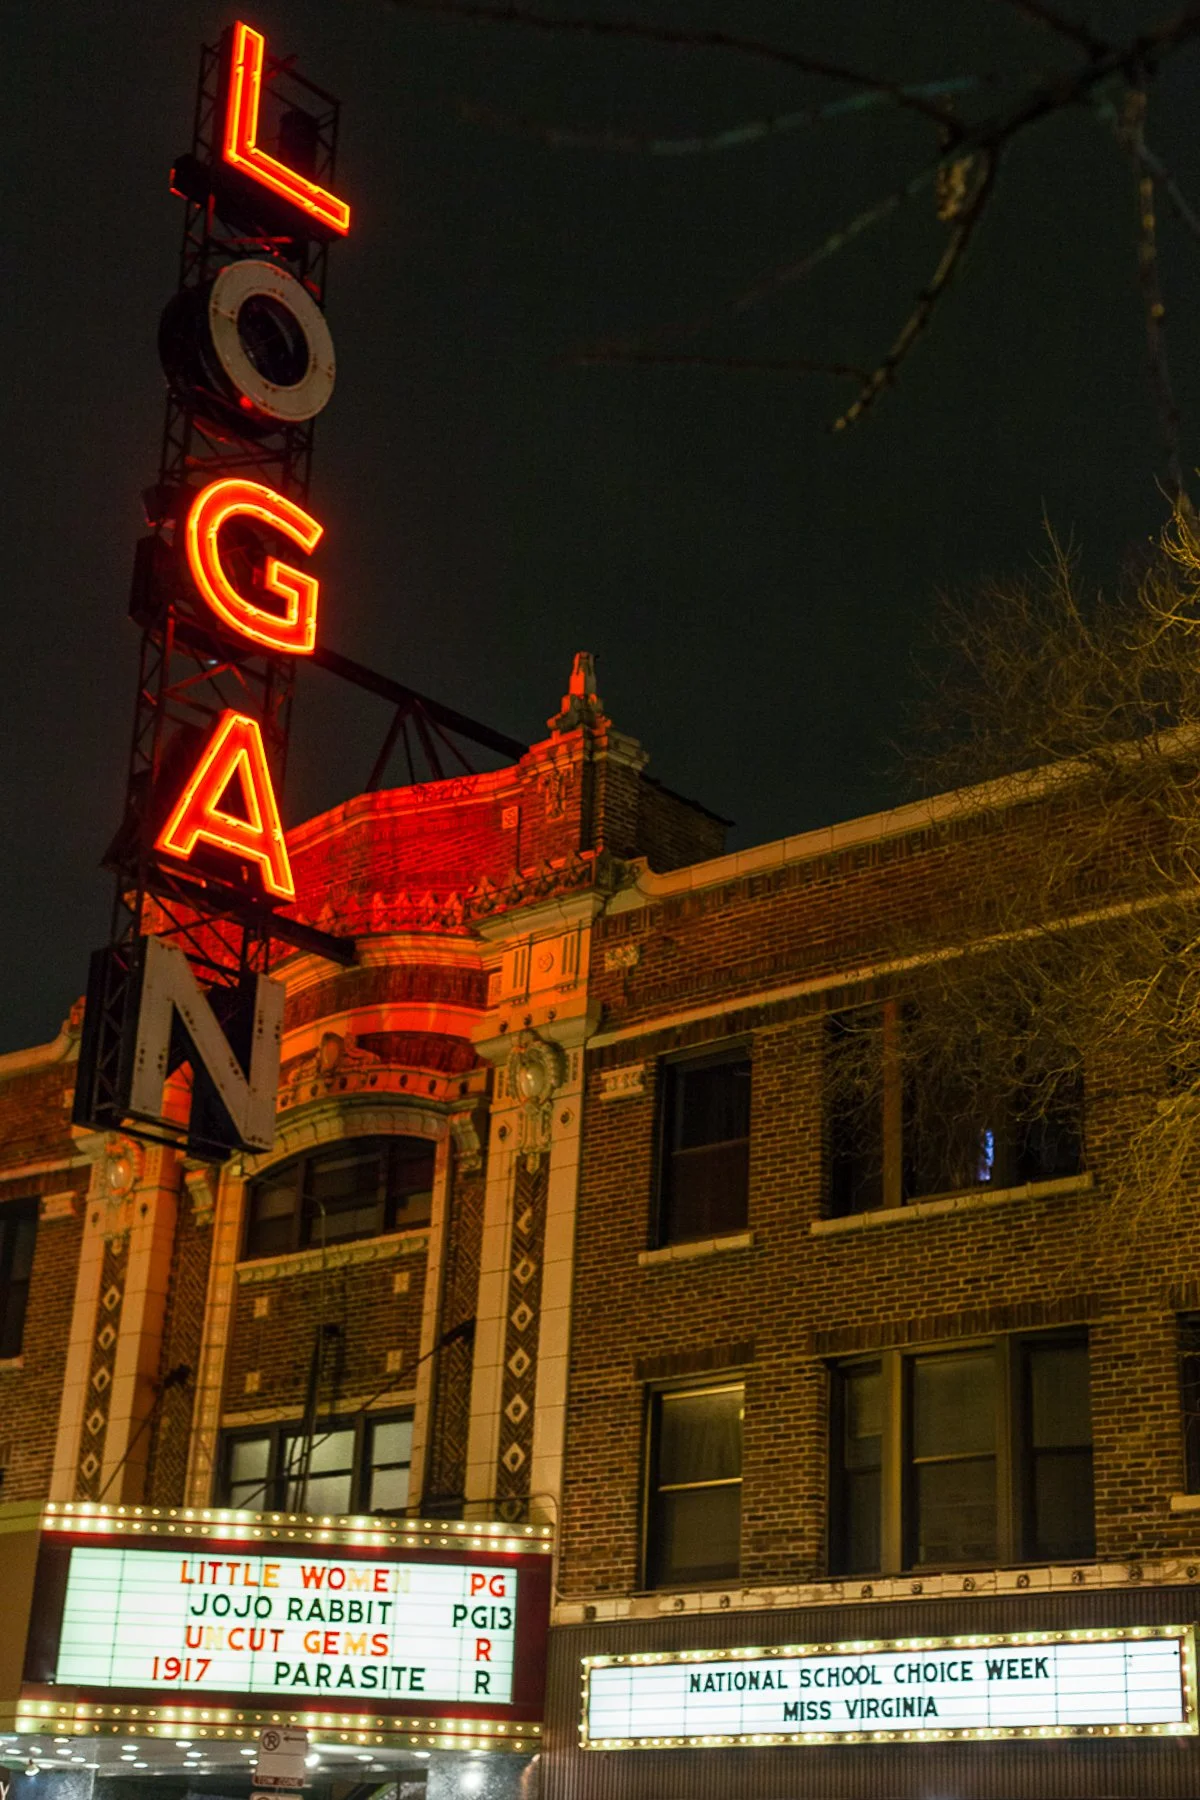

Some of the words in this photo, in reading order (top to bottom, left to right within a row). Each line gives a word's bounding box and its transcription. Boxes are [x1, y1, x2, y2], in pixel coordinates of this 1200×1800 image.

[128, 20, 352, 1152] LOGAN
[180, 1560, 281, 1588] LITTLE
[301, 1565, 411, 1593] WOMEN
[470, 1573, 506, 1598] PG
[190, 1593, 272, 1619] JOJO
[287, 1597, 393, 1624] RABBIT
[452, 1604, 513, 1630] PG13
[185, 1625, 285, 1652] UNCUT
[303, 1630, 389, 1657] GEMS
[475, 1637, 492, 1662] R
[152, 1656, 212, 1682] 1917
[273, 1661, 426, 1691] PARASITE
[474, 1670, 491, 1695] R
[689, 1669, 788, 1693] NATIONAL
[800, 1665, 883, 1688] SCHOOL
[894, 1661, 974, 1683] CHOICE
[985, 1656, 1050, 1680] WEEK
[783, 1700, 832, 1722] MISS
[845, 1696, 939, 1719] VIRGINIA
